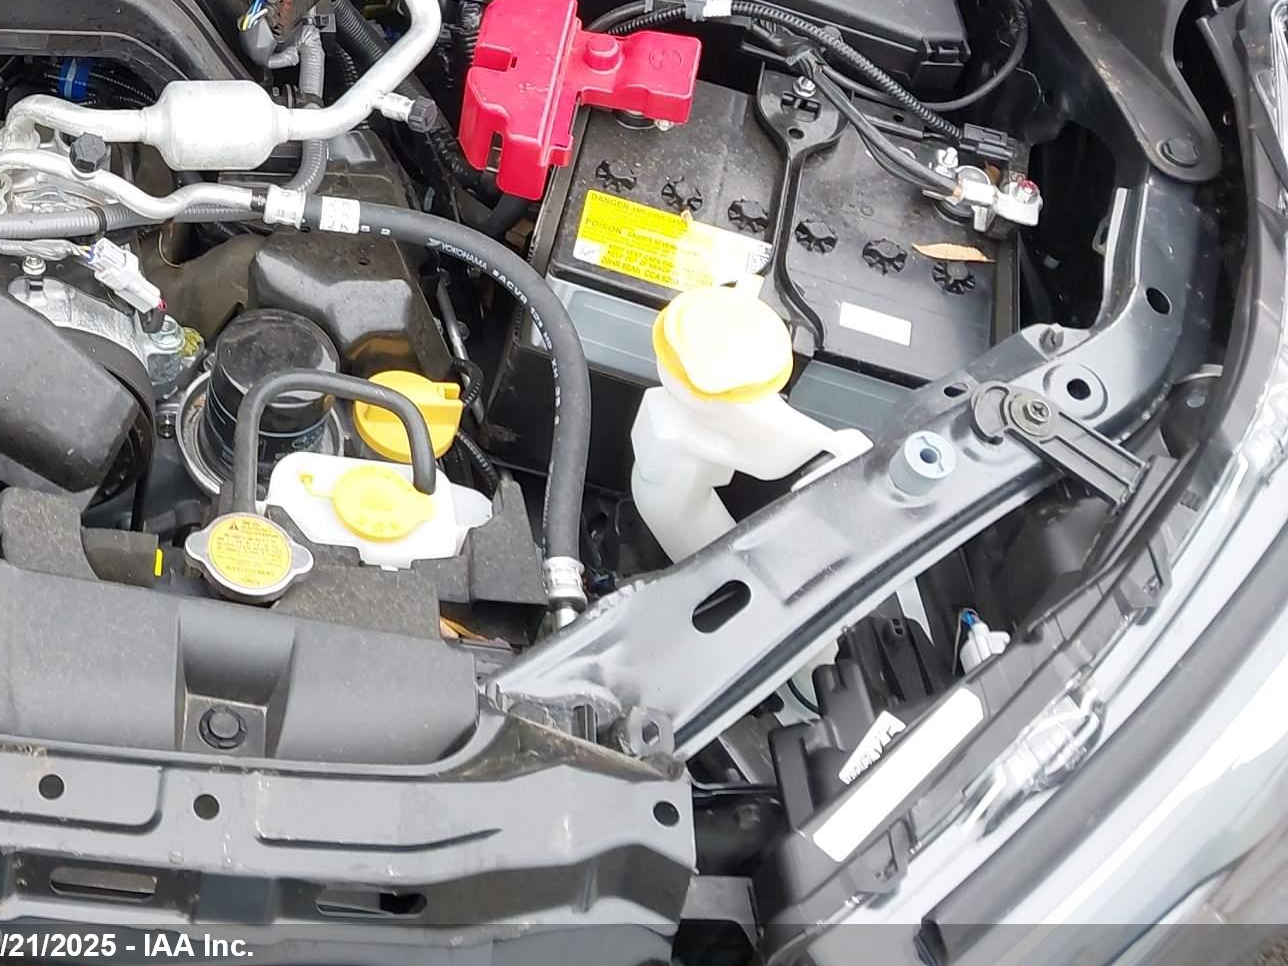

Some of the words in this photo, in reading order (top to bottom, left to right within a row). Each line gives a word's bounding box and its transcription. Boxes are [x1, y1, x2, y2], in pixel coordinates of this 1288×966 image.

[590, 193, 630, 210] DANGER
[585, 217, 623, 234] POISON
[441, 241, 487, 270] YOKOHAMA
